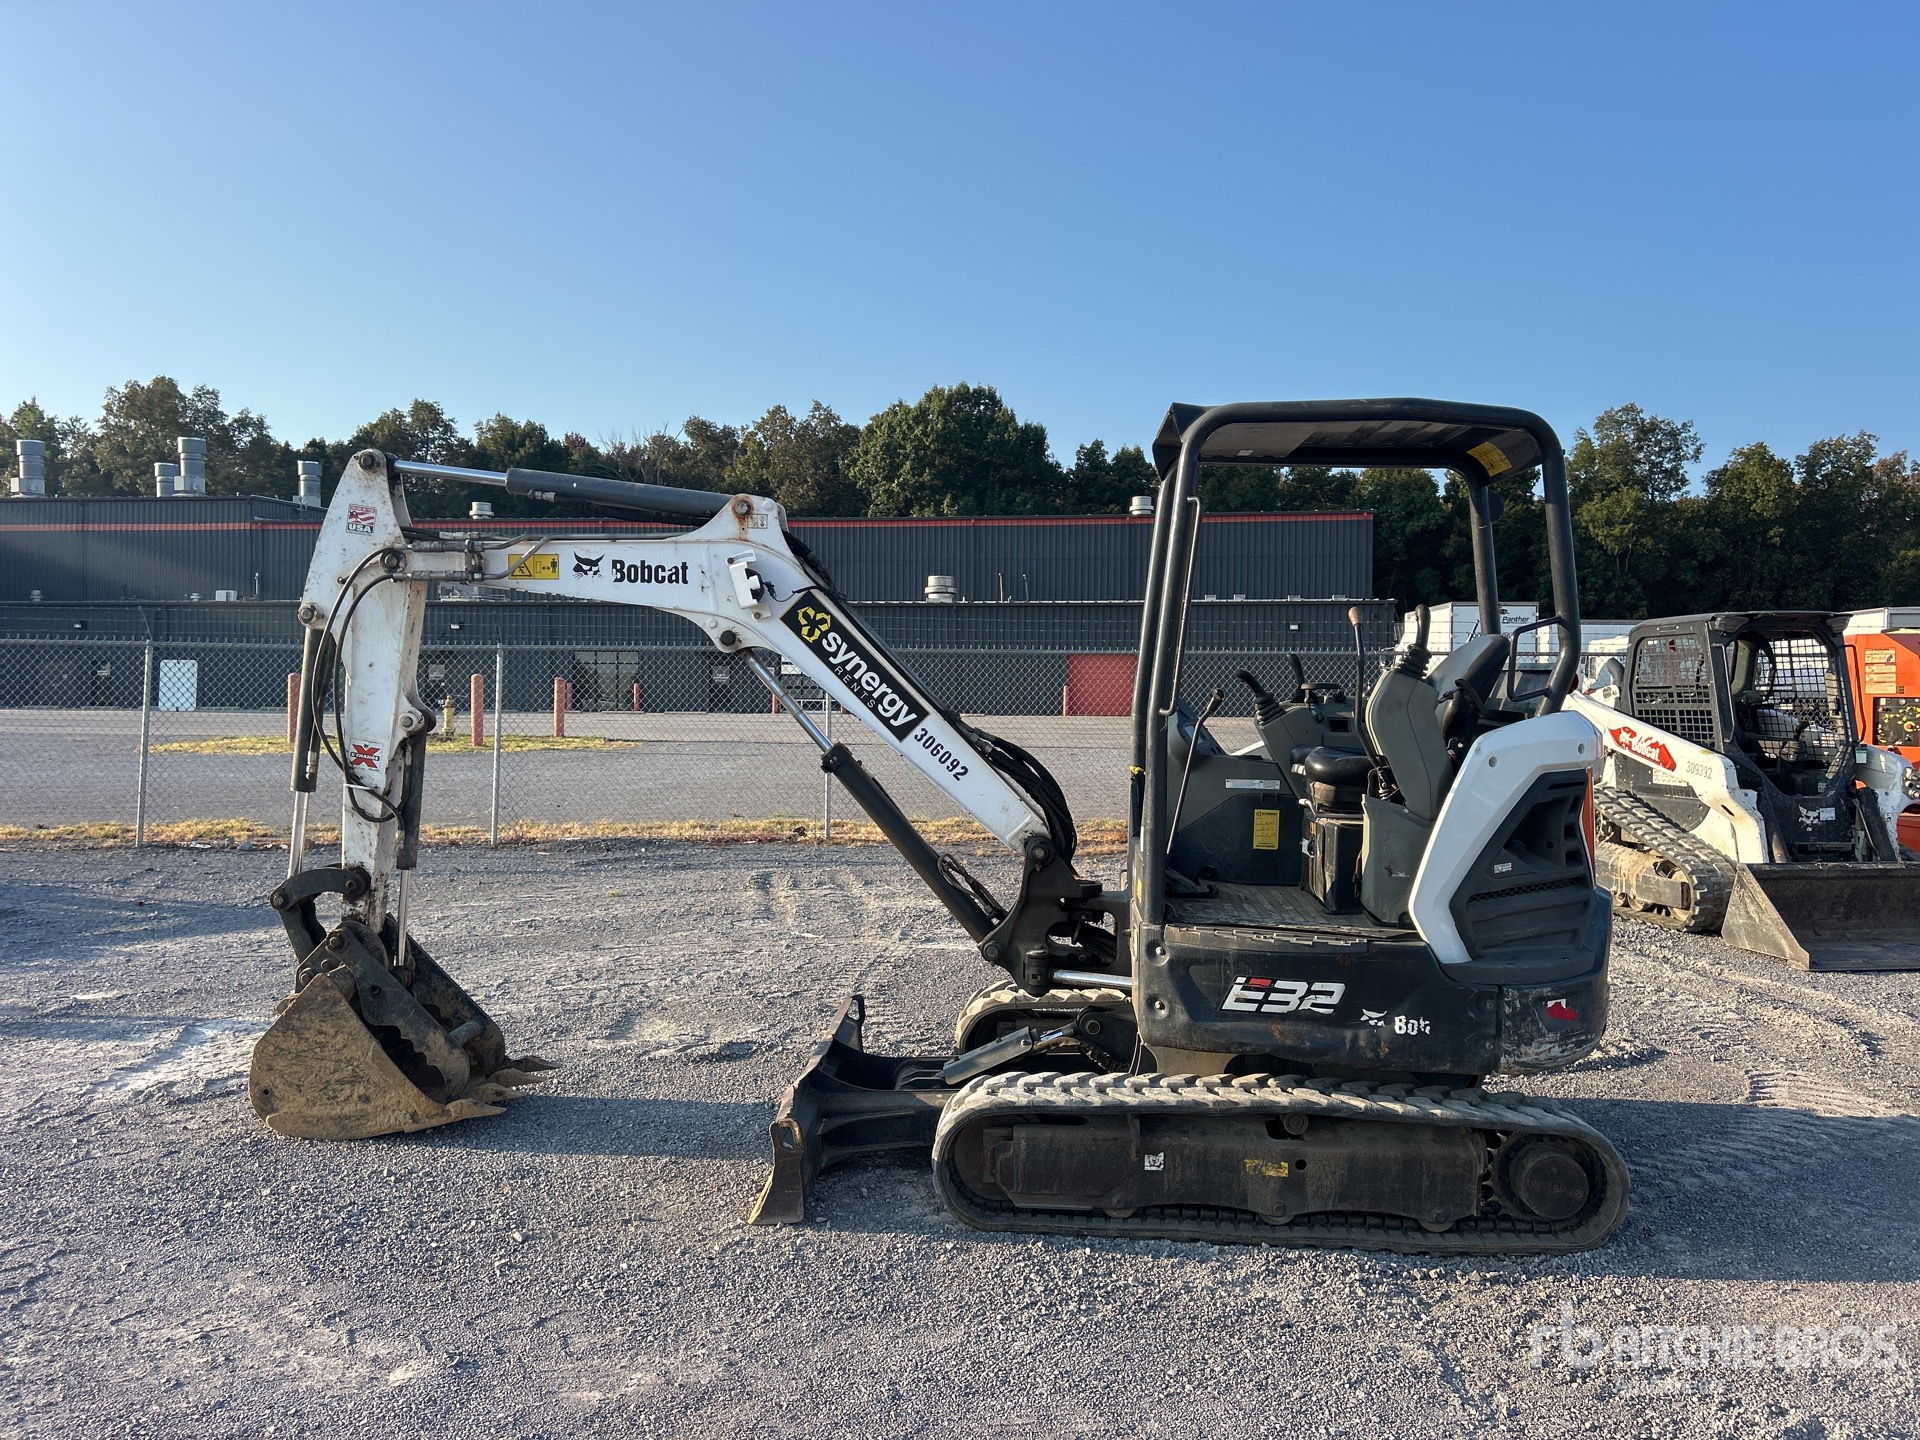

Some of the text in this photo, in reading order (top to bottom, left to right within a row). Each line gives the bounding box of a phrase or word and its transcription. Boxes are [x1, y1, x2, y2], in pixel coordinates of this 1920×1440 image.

[348, 523, 372, 533] USA
[612, 559, 688, 584] Bobcat
[821, 631, 917, 727] synergy
[834, 666, 876, 708] RENTS
[914, 727, 969, 781] 306092
[1632, 738, 1660, 762] Bobcat
[1685, 761, 1713, 779] 309392
[1221, 976, 1346, 1015] E32
